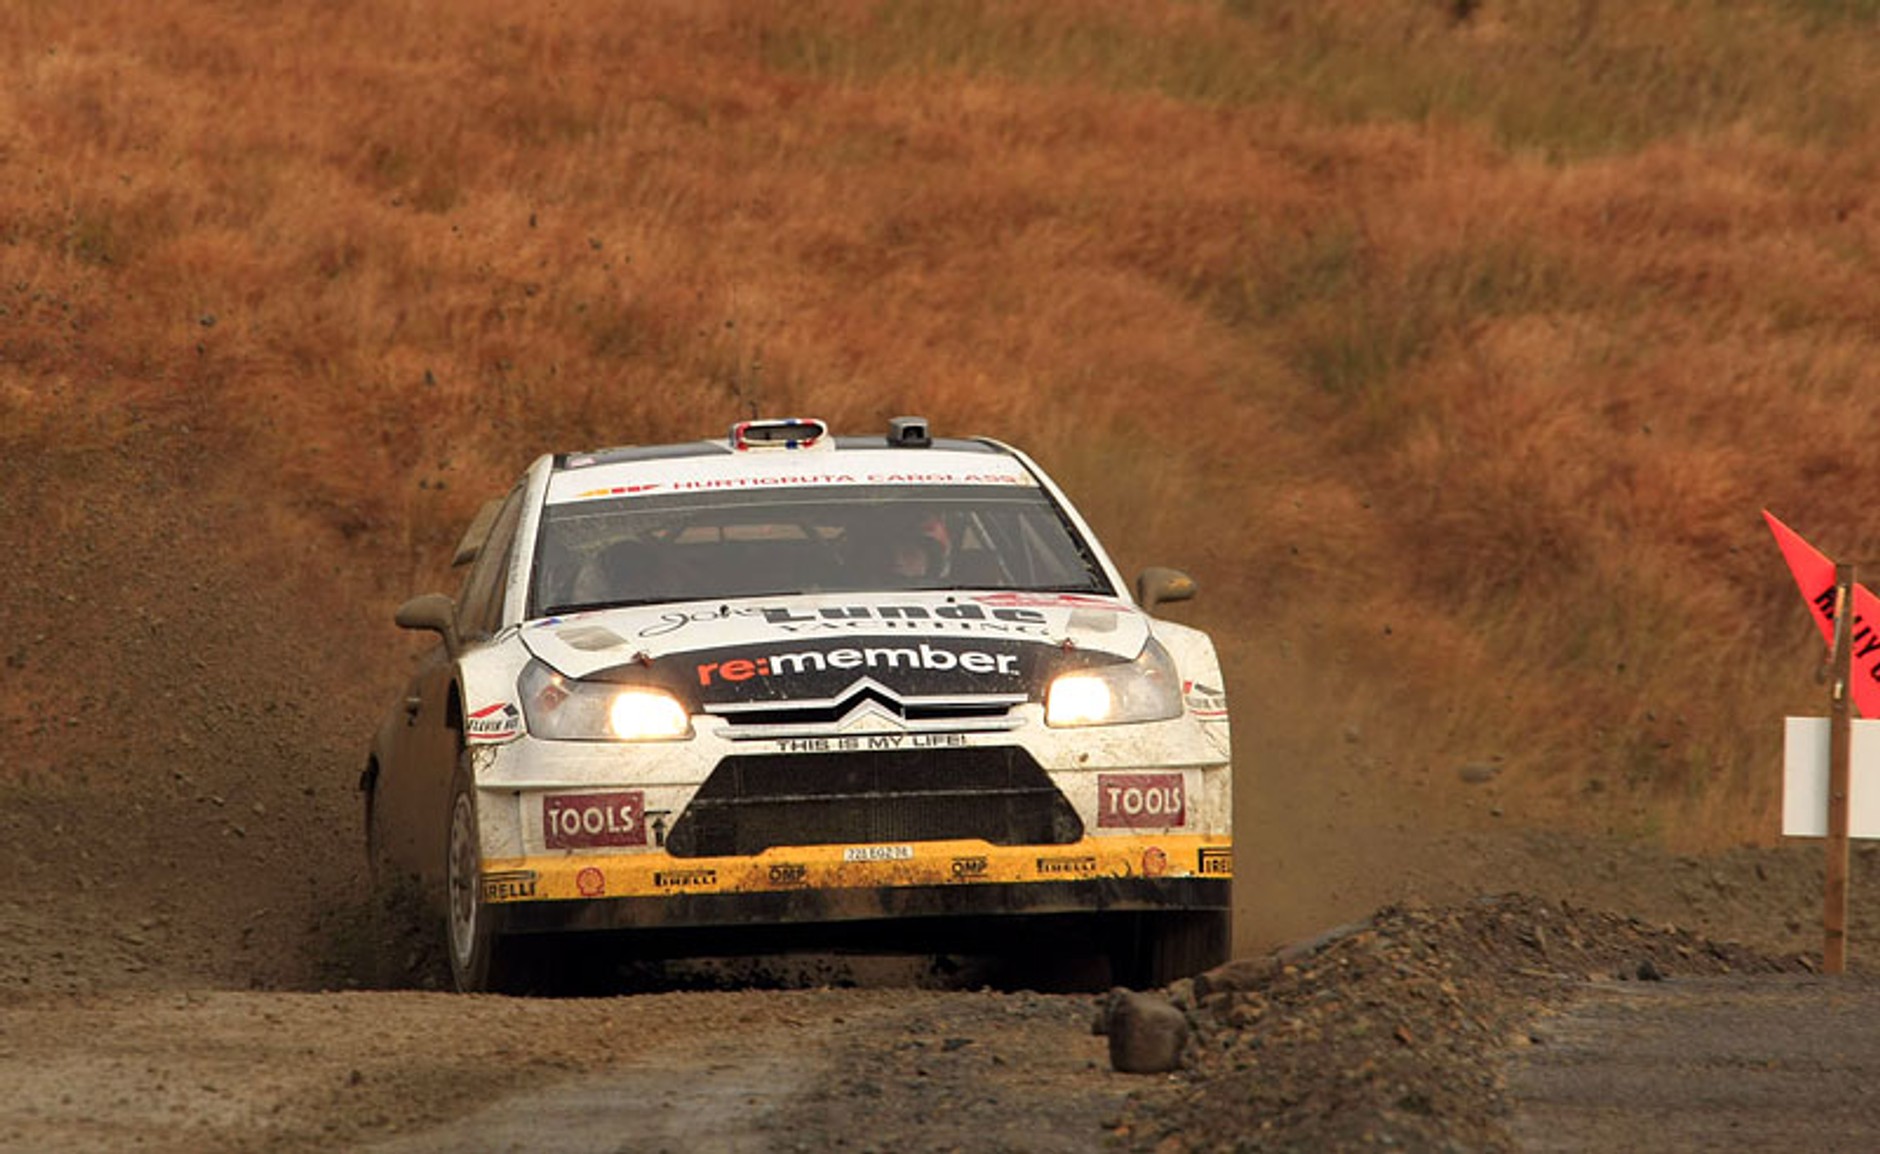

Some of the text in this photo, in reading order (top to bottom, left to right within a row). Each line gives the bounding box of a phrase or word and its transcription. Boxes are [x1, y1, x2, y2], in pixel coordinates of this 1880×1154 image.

[673, 475, 856, 489] HURTIGRUTA
[762, 603, 1048, 625] Lunde
[778, 621, 1051, 636] YACHTING
[776, 733, 966, 751] THIS IS MY LIFE!
[1107, 787, 1183, 815] TOOLS
[548, 805, 633, 835] TOOLS
